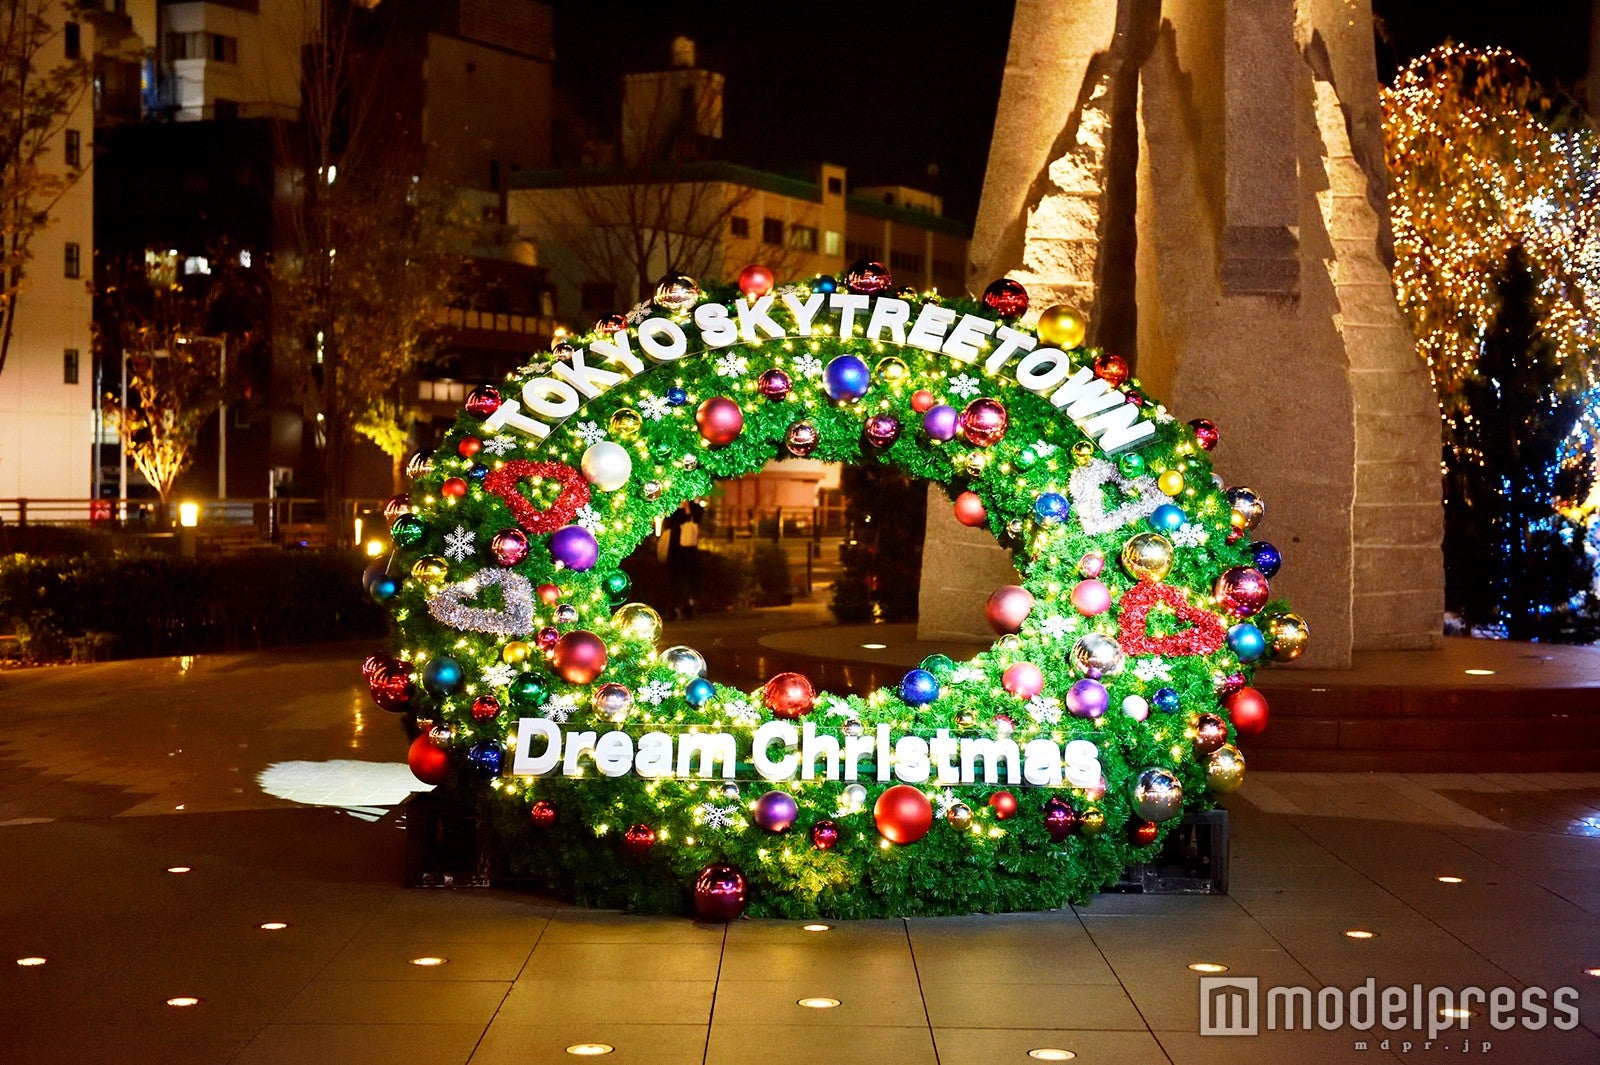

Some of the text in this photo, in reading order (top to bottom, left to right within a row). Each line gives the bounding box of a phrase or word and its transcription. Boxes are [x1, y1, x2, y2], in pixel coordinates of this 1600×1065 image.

[486, 317, 687, 439] TOKYO
[512, 717, 1103, 787] Dream Christmas
